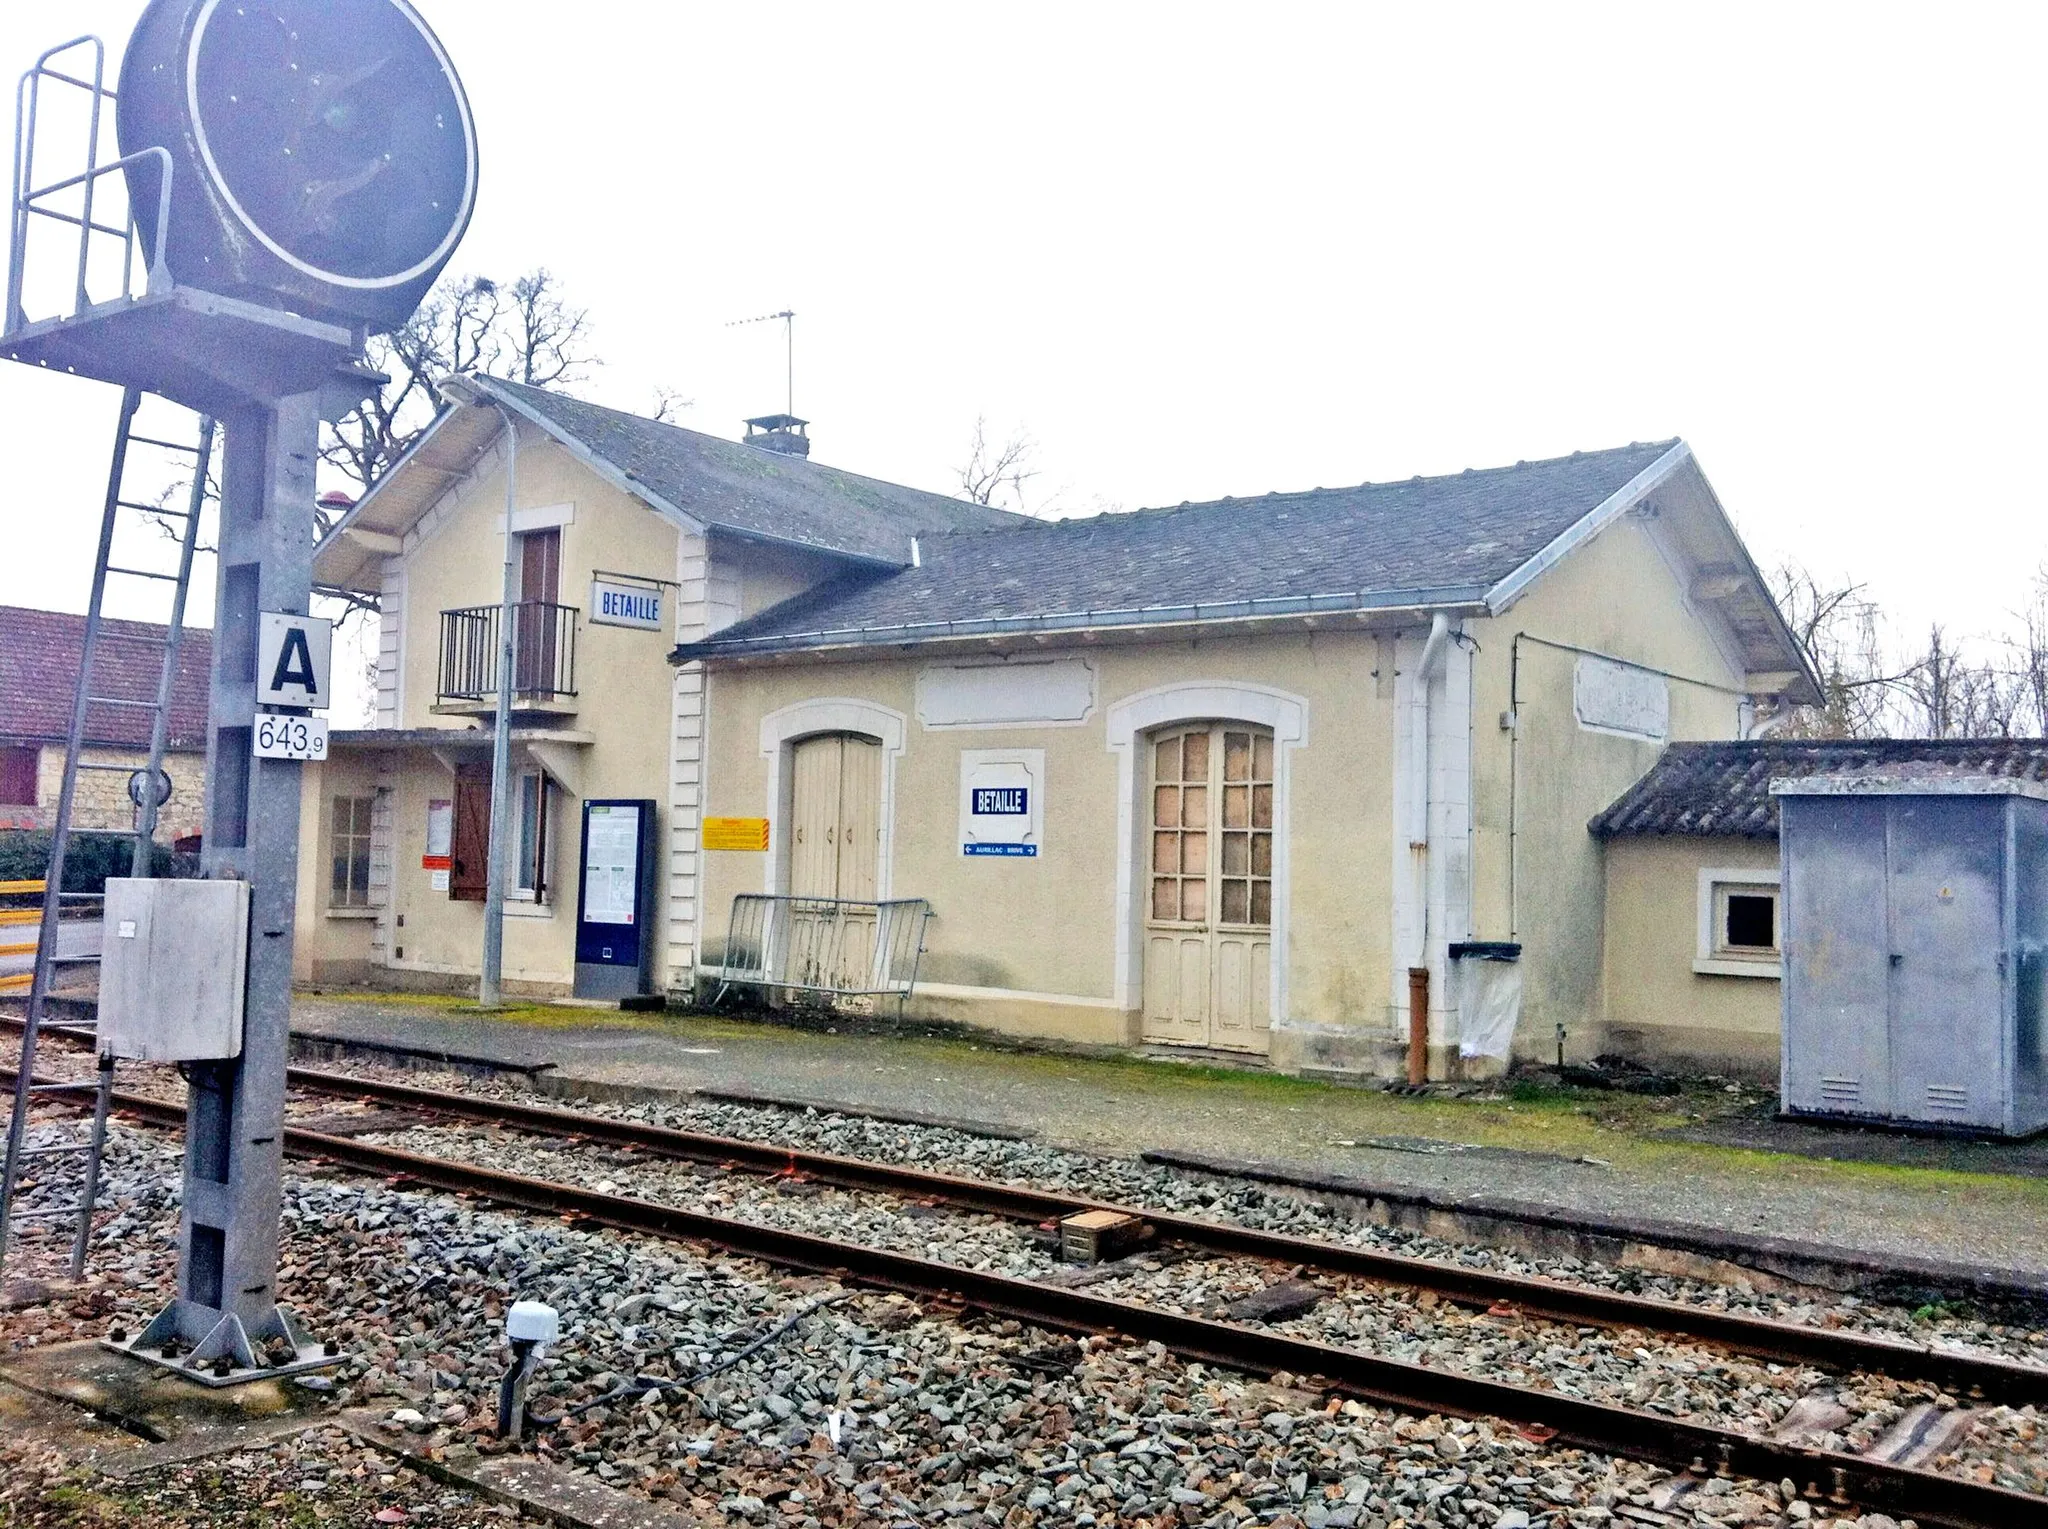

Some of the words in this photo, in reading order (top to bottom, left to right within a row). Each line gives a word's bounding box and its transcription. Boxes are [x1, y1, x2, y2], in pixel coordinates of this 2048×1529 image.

[602, 591, 658, 621] BETAILLE
[270, 627, 318, 694] A
[978, 790, 1022, 812] BETAILLE
